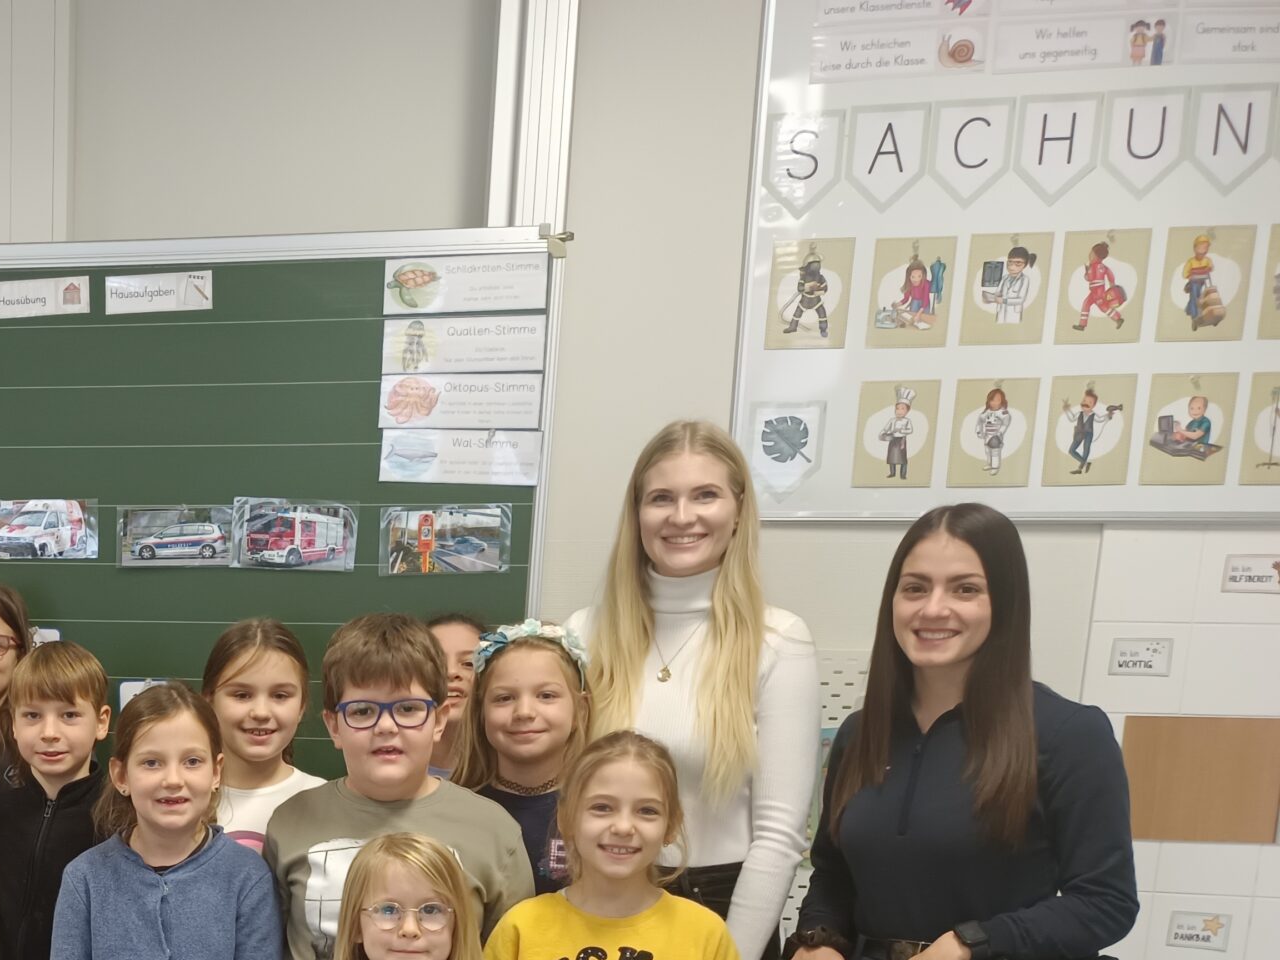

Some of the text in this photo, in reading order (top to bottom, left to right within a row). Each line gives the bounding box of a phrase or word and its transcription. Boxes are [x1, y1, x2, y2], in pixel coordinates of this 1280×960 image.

[824, 5, 856, 16] unsere
[1035, 26, 1088, 40] Wir helfen
[1195, 22, 1257, 34] Gemeinsam
[839, 38, 912, 52] Wir schleichen
[1231, 39, 1257, 52] stark
[1018, 51, 1037, 60] uns
[845, 58, 872, 71] durch
[875, 57, 891, 68] die
[110, 287, 176, 302] Hausaufgaben
[446, 324, 537, 338] Quallen-Stimme
[443, 381, 536, 394] Oktopus-Stimme
[451, 437, 519, 450] Wal-Stimme
[1117, 659, 1153, 669] WICHTIG
